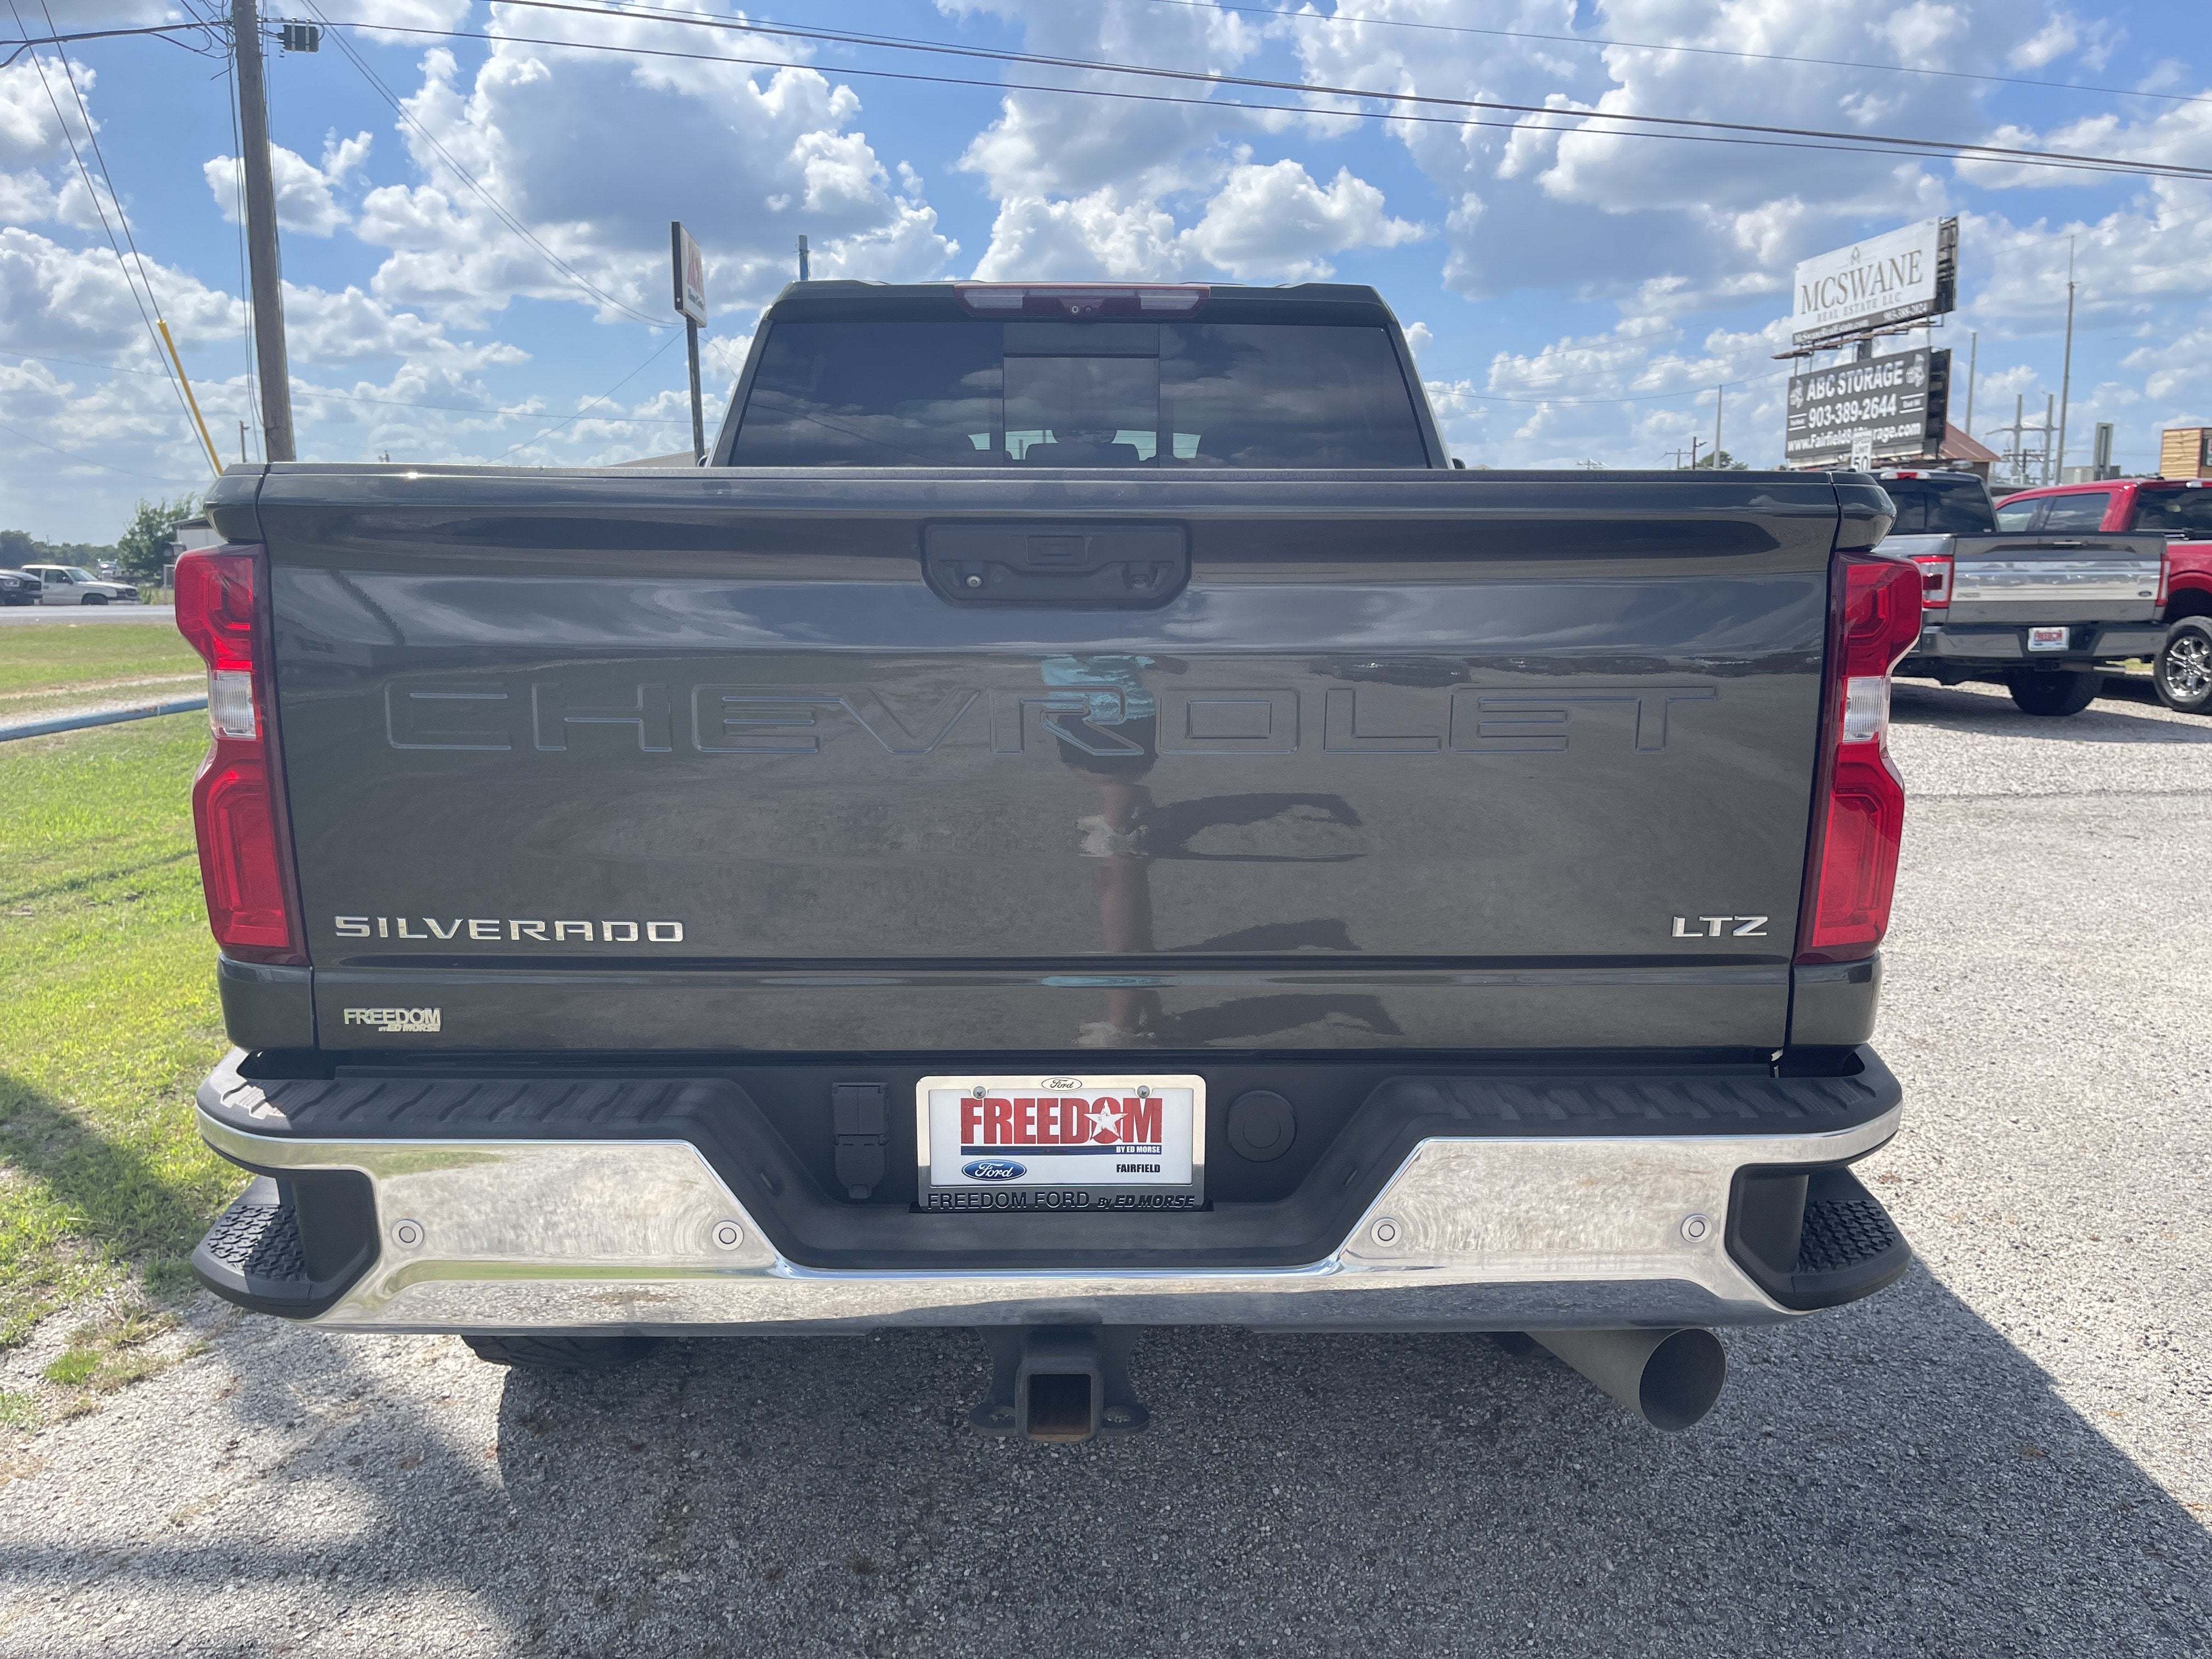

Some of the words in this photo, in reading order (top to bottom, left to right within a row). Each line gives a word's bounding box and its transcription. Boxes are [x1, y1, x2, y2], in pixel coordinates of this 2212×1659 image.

[1801, 249, 1923, 315] MCSWANE
[1843, 298, 1878, 317] ESTATE
[1883, 292, 1901, 306] LLC
[1805, 374, 1836, 402] ABC
[1837, 360, 1904, 396] STORAGE
[1808, 393, 1897, 429] 903-389-2644
[1853, 456, 1869, 471] 50
[384, 682, 1718, 756] CHEVROLET
[335, 916, 684, 942] SILVERADO
[1672, 916, 1768, 936] LTZ
[344, 1007, 441, 1025] FREEDOM
[402, 1024, 440, 1032] MORSE
[961, 1097, 1163, 1144] FREEDOM
[974, 1162, 1014, 1177] Ford
[1116, 1164, 1161, 1173] FAIRFIELD
[928, 1192, 1027, 1209] FREEDOM
[1035, 1191, 1090, 1209] FORD
[1097, 1197, 1112, 1210] By
[1114, 1195, 1135, 1207] ED
[1137, 1194, 1195, 1207] MORSE
